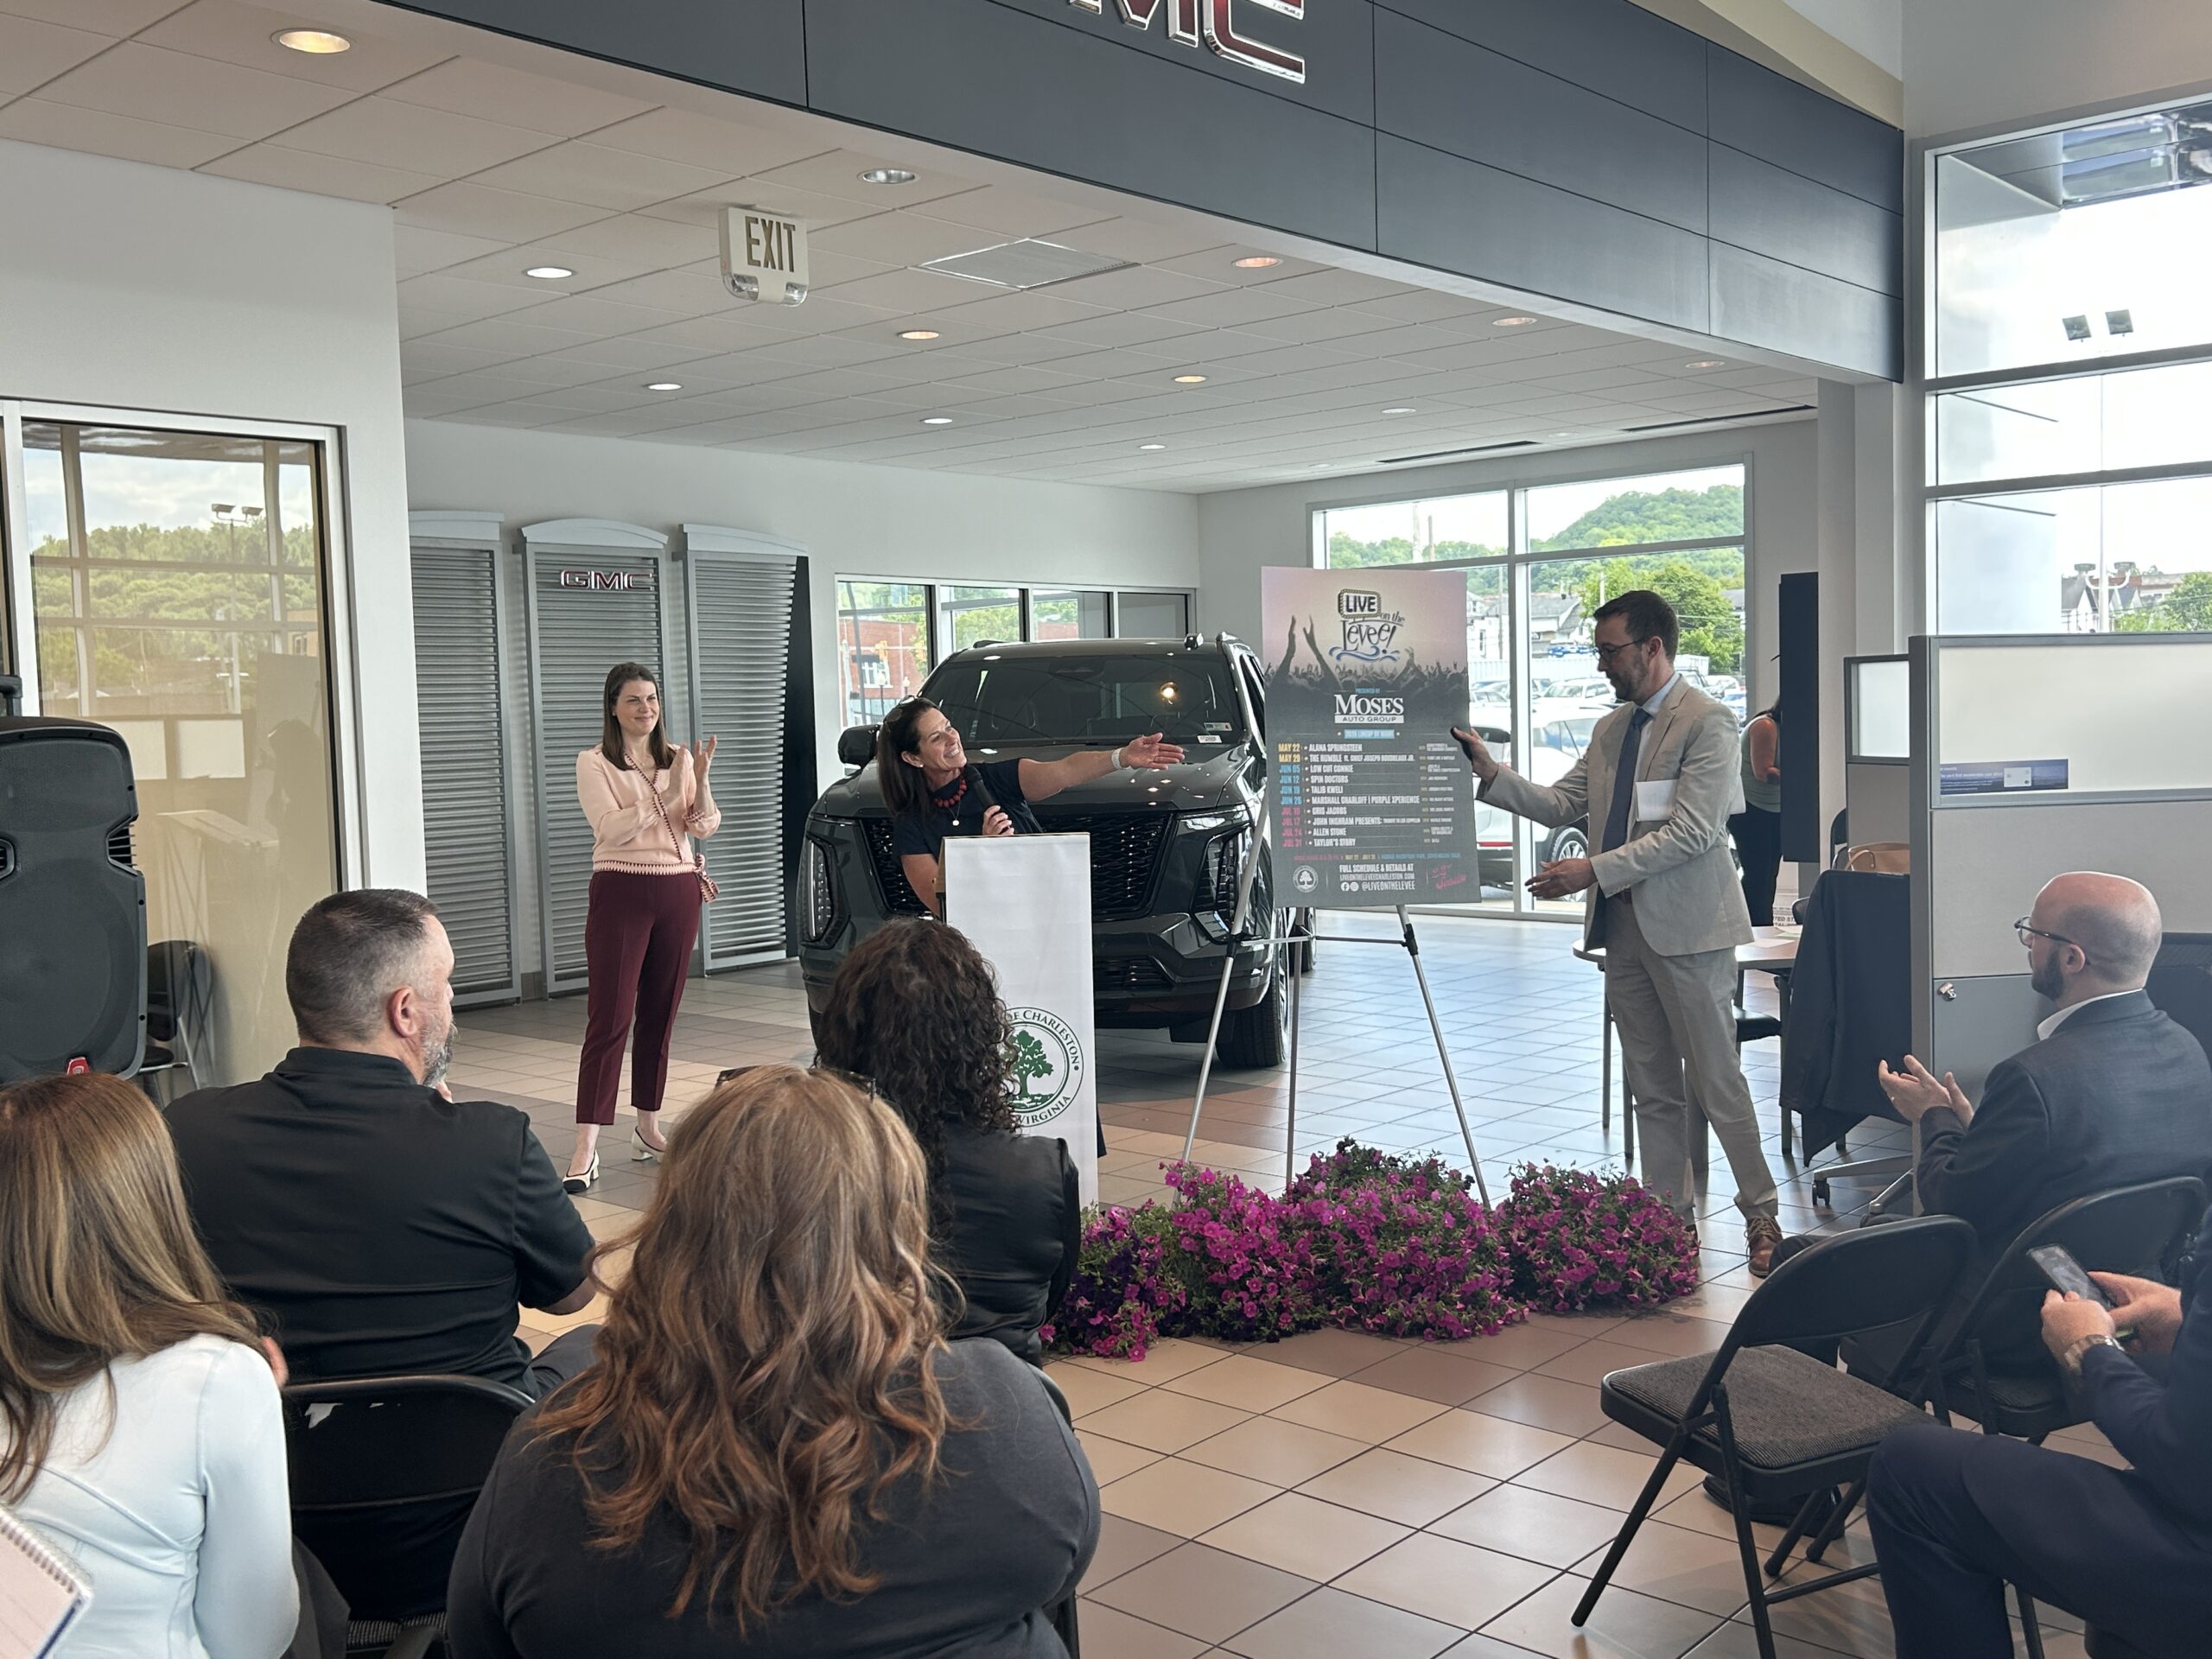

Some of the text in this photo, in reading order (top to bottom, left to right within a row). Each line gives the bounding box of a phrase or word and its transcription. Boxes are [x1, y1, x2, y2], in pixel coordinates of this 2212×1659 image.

[745, 215, 796, 272] EXIT
[561, 570, 655, 590] GMC
[1345, 594, 1376, 613] LIVE
[1391, 611, 1406, 623] the
[1333, 694, 1404, 716] MOSES
[1279, 743, 1363, 752] MAY 22 ALANA SPRINGSTEEN
[1279, 754, 1292, 763] MAY
[1280, 765, 1293, 773] JUN
[1280, 775, 1349, 784] JUN 12 SPIN DOCTORS
[1280, 785, 1293, 794] JUN
[1311, 785, 1326, 794] TALIB
[1281, 796, 1294, 804] JUN
[1312, 796, 1340, 804] MARSHALL
[1391, 795, 1420, 804] XPERIENCE
[1281, 806, 1292, 816] JUL
[1281, 817, 1293, 826] JUL
[1354, 817, 1383, 825] PRESENTS:
[1313, 828, 1329, 836] ALLEN
[1313, 838, 1338, 847] TAYLOR'S
[1339, 838, 1356, 847] STORY
[1339, 864, 1352, 873] FULL
[1352, 864, 1380, 873] SCHEDULE
[1385, 863, 1407, 872] DETAILS
[1407, 863, 1414, 872] AT
[1361, 880, 1415, 892] @LIVEONTHELEVEE
[1023, 1009, 1080, 1065] CHARLESTON
